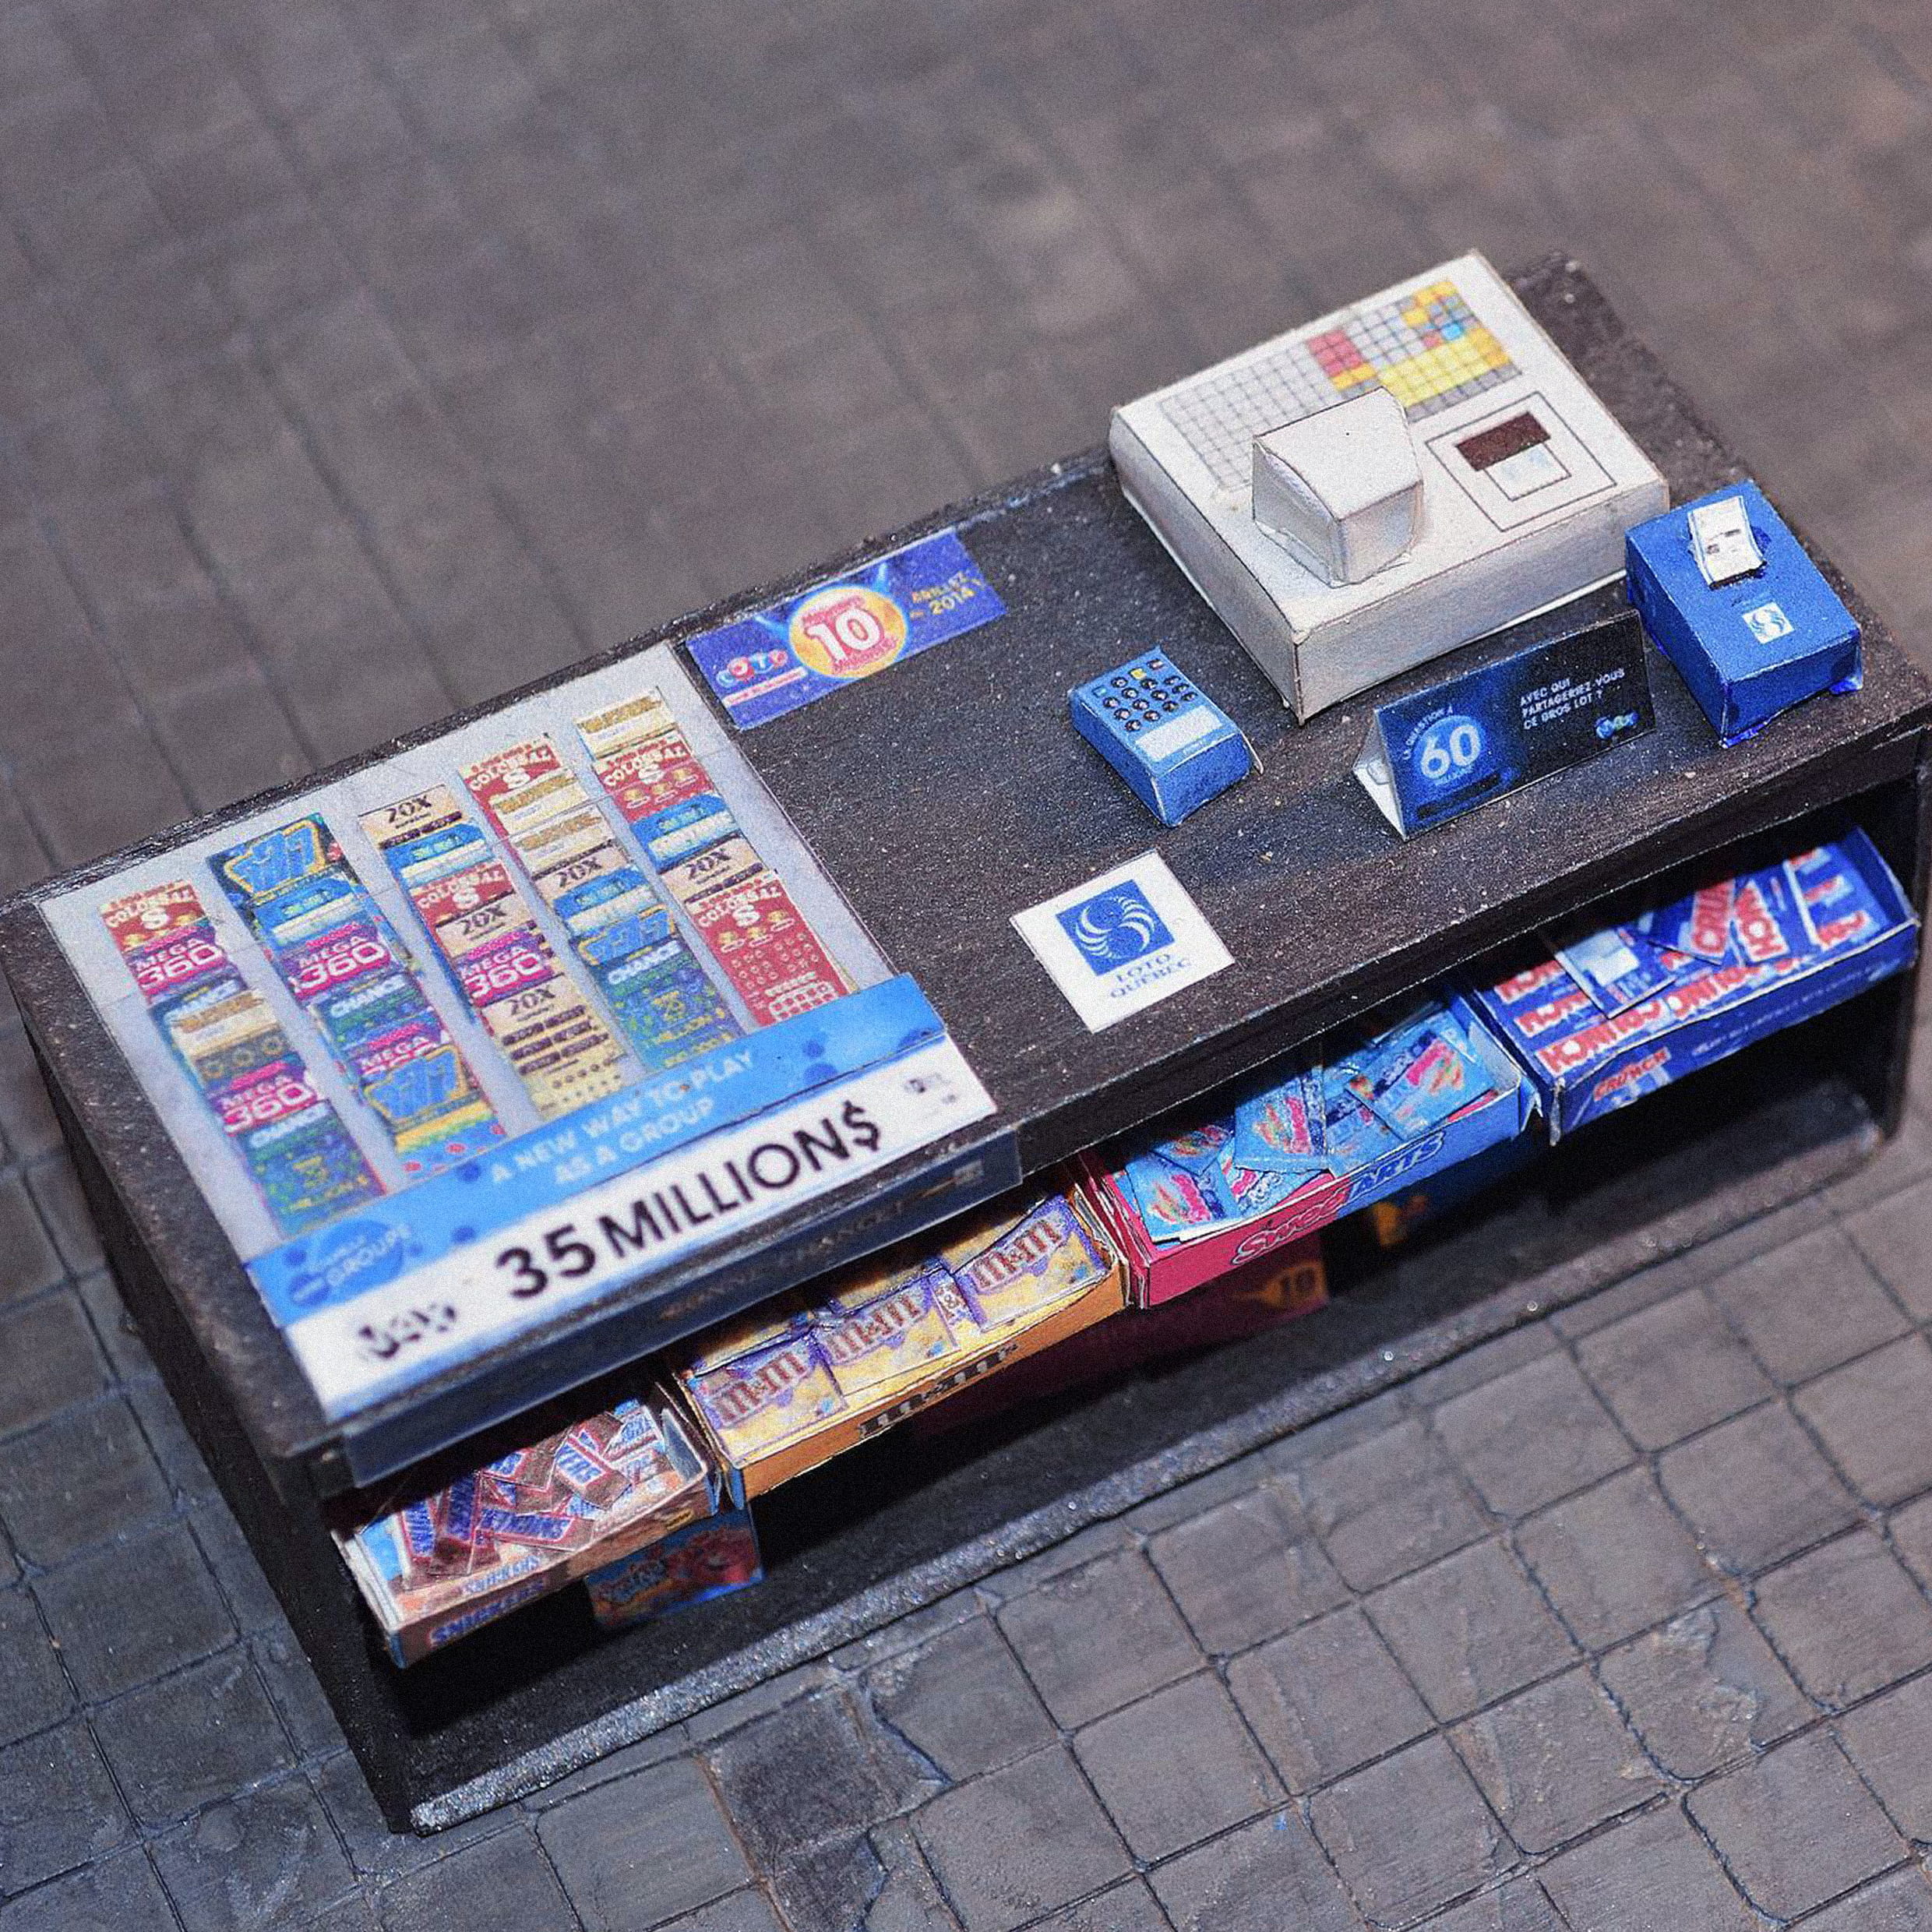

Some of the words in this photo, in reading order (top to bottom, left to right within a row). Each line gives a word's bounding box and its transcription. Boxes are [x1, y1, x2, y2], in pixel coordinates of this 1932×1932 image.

[805, 608, 881, 664] 10
[1520, 688, 1547, 707] AVEC
[1551, 678, 1571, 693] QUI
[1421, 724, 1480, 779] 60
[386, 795, 432, 823] 20X
[138, 944, 222, 989] 360
[299, 936, 366, 968] MEGA
[301, 942, 385, 989] 360
[460, 946, 531, 978] MEGA
[465, 953, 540, 998] 360
[1116, 954, 1172, 983] LOTO
[1593, 1048, 1669, 1102] CRUNCH
[224, 1082, 313, 1132] 360
[493, 1163, 513, 1183] A
[515, 1130, 576, 1169] NEW
[584, 1099, 642, 1137] WAY
[690, 1049, 753, 1089] PLAY
[619, 1095, 714, 1152] GROUP
[496, 1224, 596, 1299] 35
